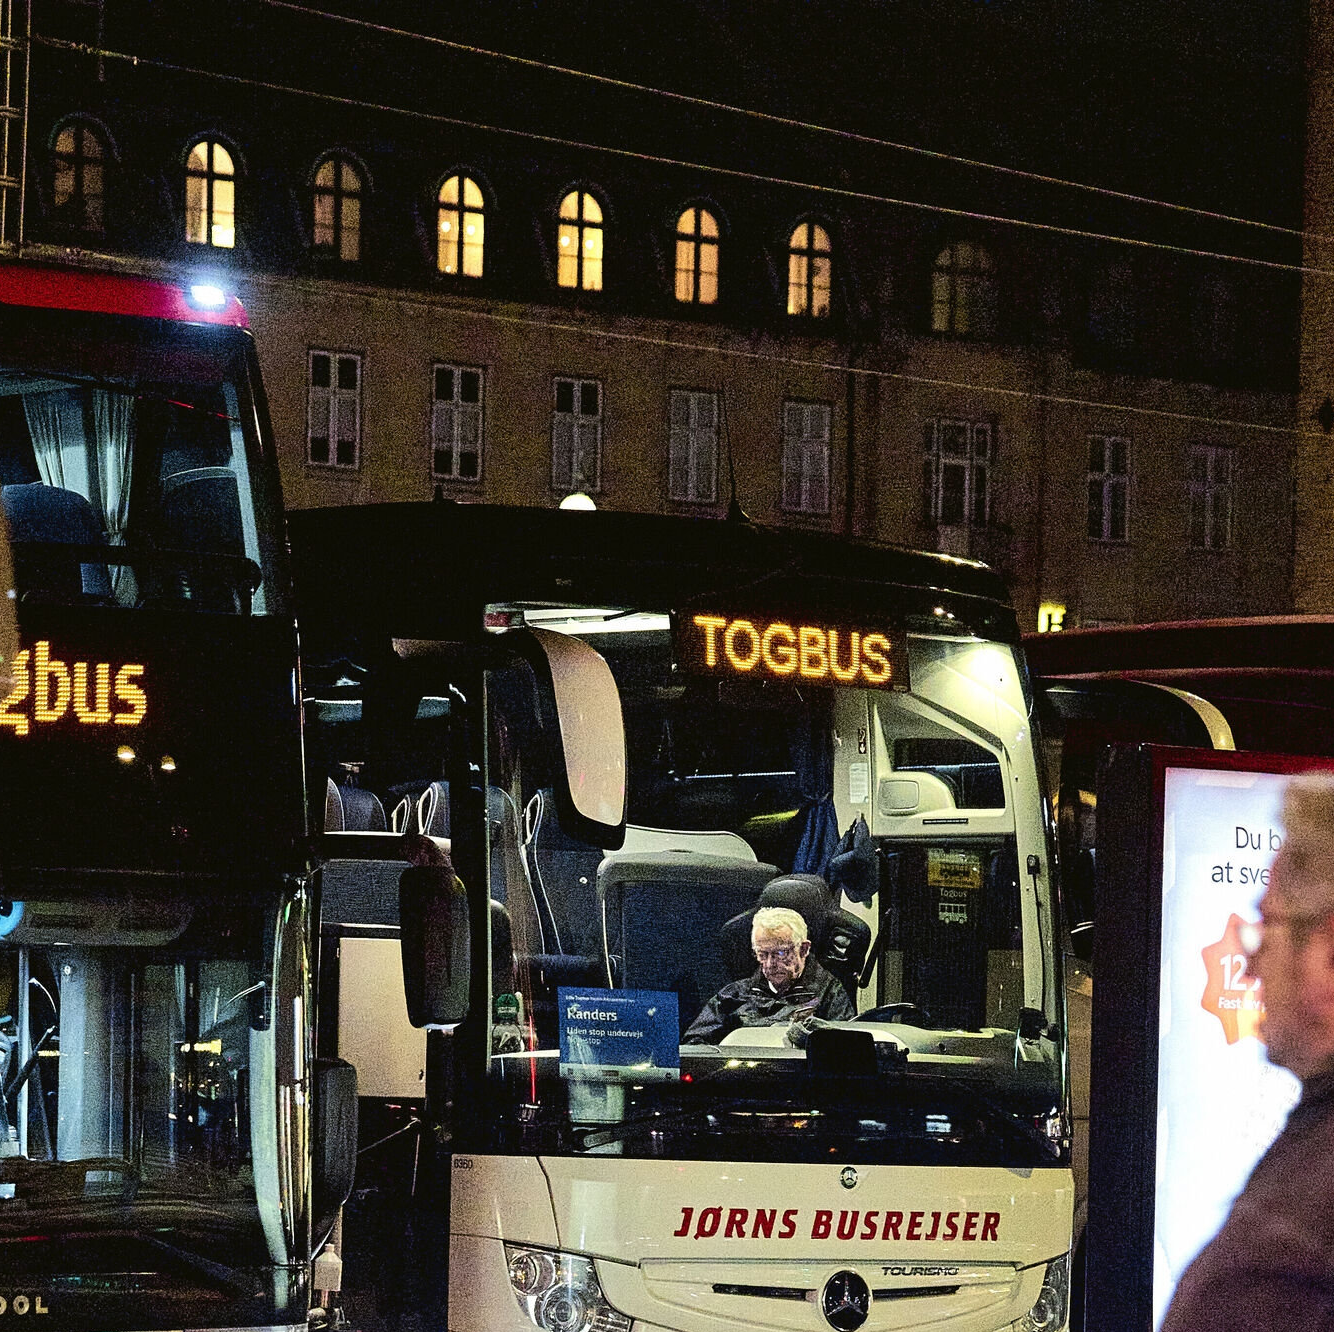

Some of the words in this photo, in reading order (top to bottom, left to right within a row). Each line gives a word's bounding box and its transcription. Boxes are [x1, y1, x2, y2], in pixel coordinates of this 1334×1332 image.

[693, 614, 893, 683] TOGBUS
[1235, 826, 1262, 851] Du
[1211, 861, 1234, 884] at
[1239, 866, 1271, 887] sve
[567, 1007, 618, 1022] Randers
[588, 1028, 606, 1038] stop
[673, 1205, 799, 1241] JØRNS
[810, 1209, 1002, 1242] BUSREJSER
[881, 1266, 960, 1277] TOURISMO
